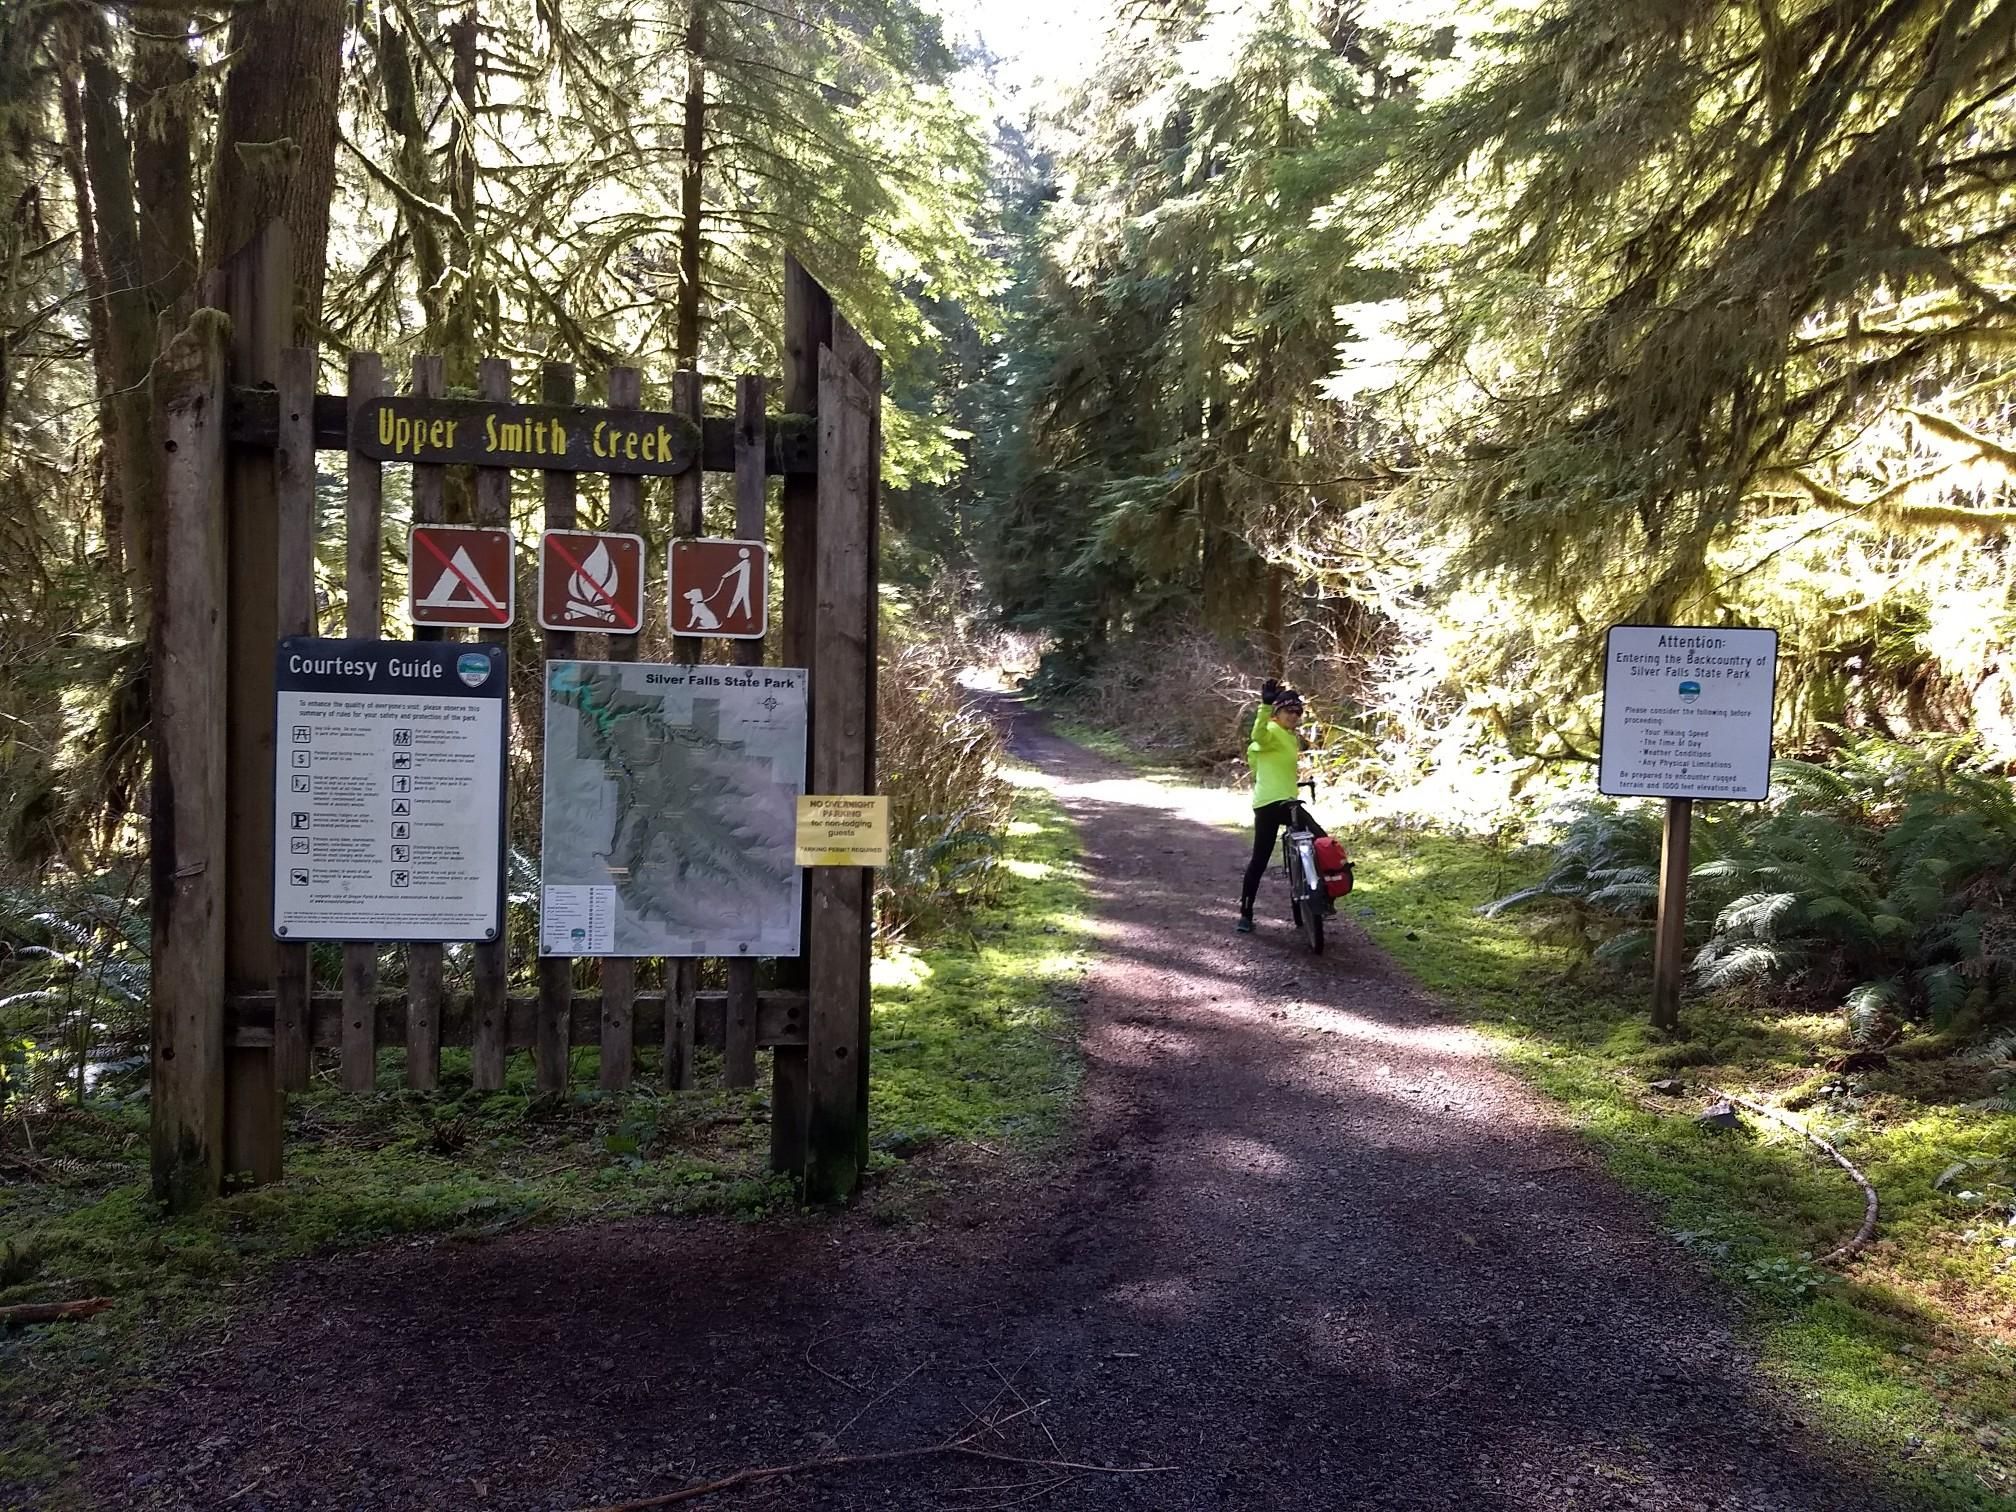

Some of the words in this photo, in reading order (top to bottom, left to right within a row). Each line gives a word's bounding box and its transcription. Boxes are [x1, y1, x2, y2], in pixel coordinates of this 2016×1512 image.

[379, 408, 458, 454] Upper
[485, 414, 567, 455] Smith
[592, 421, 673, 463] Creek
[1658, 635, 1726, 648] Attention:
[1616, 653, 1660, 665] Entering
[1665, 654, 1681, 664] the
[1687, 654, 1752, 667] Backcountry
[1756, 656, 1767, 666] of
[289, 655, 377, 681] Courtesy
[388, 659, 443, 678] Guide
[1630, 666, 1660, 676] Silver
[1666, 667, 1689, 677] Falls
[1694, 668, 1721, 678] State
[1726, 669, 1750, 678] Park
[646, 674, 684, 684] Silver
[689, 676, 720, 686] Falls
[724, 677, 760, 687] State
[764, 678, 794, 688] Park
[423, 704, 442, 712] please
[299, 710, 326, 718] summary
[1697, 709, 1727, 717] following
[1664, 730, 1685, 738] Hiking
[1688, 740, 1701, 748] Day
[1643, 749, 1671, 757] Weather
[1675, 750, 1711, 758] Conditions
[1642, 759, 1656, 767] Any
[1660, 760, 1690, 768] Physical
[1692, 761, 1731, 769] Limitations
[1632, 772, 1661, 780] prepared
[1675, 773, 1710, 781] encounter
[825, 820, 872, 828] non-lodging
